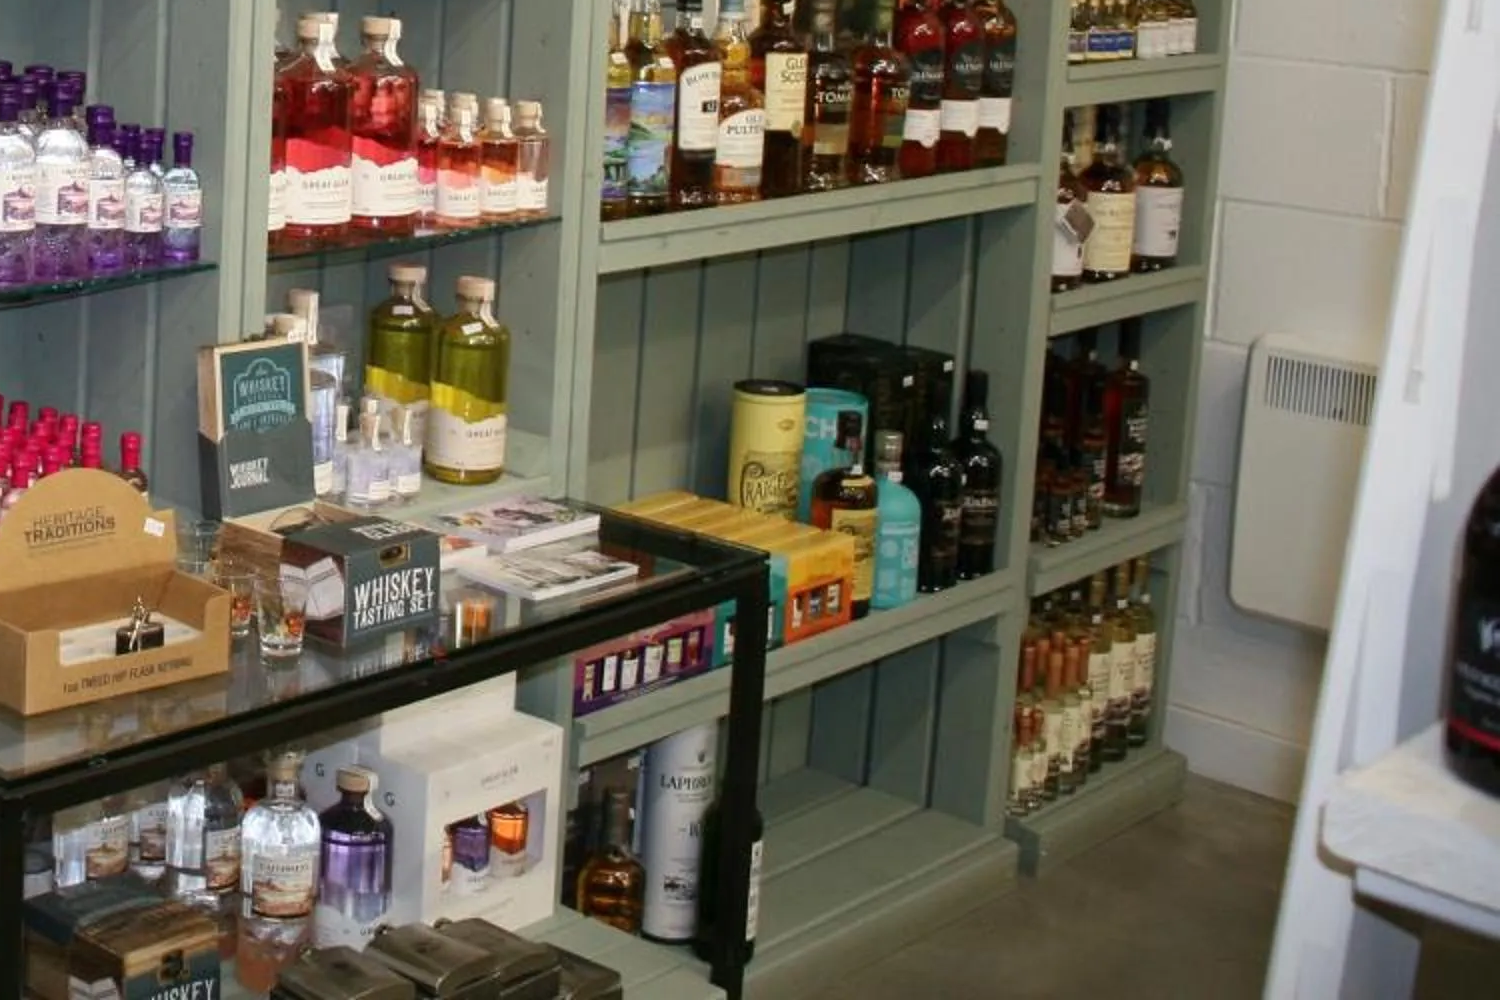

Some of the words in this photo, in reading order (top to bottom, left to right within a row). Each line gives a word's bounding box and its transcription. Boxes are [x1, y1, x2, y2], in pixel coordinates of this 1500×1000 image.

[23, 516, 116, 544] TRADITIONS
[32, 504, 105, 528] HERITAGE
[354, 567, 435, 612] WHISKEY
[353, 600, 405, 630] TASTING
[410, 592, 435, 614] SET
